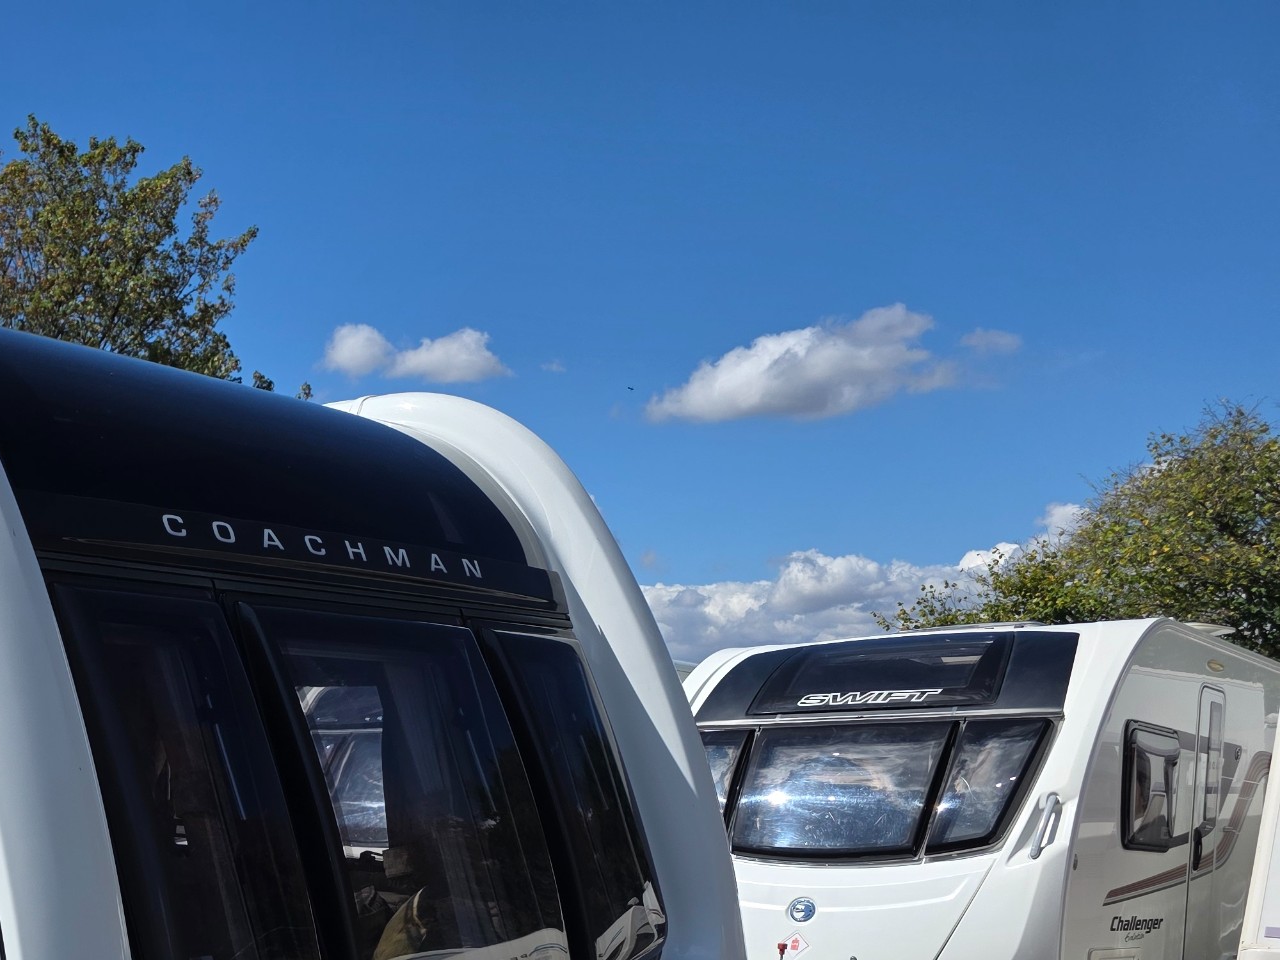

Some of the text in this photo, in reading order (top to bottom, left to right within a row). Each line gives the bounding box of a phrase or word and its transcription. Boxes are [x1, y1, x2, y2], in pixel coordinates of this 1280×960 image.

[162, 514, 483, 579] COACHMAN
[797, 688, 944, 707] SWIFT
[1110, 915, 1164, 934] Challenger
